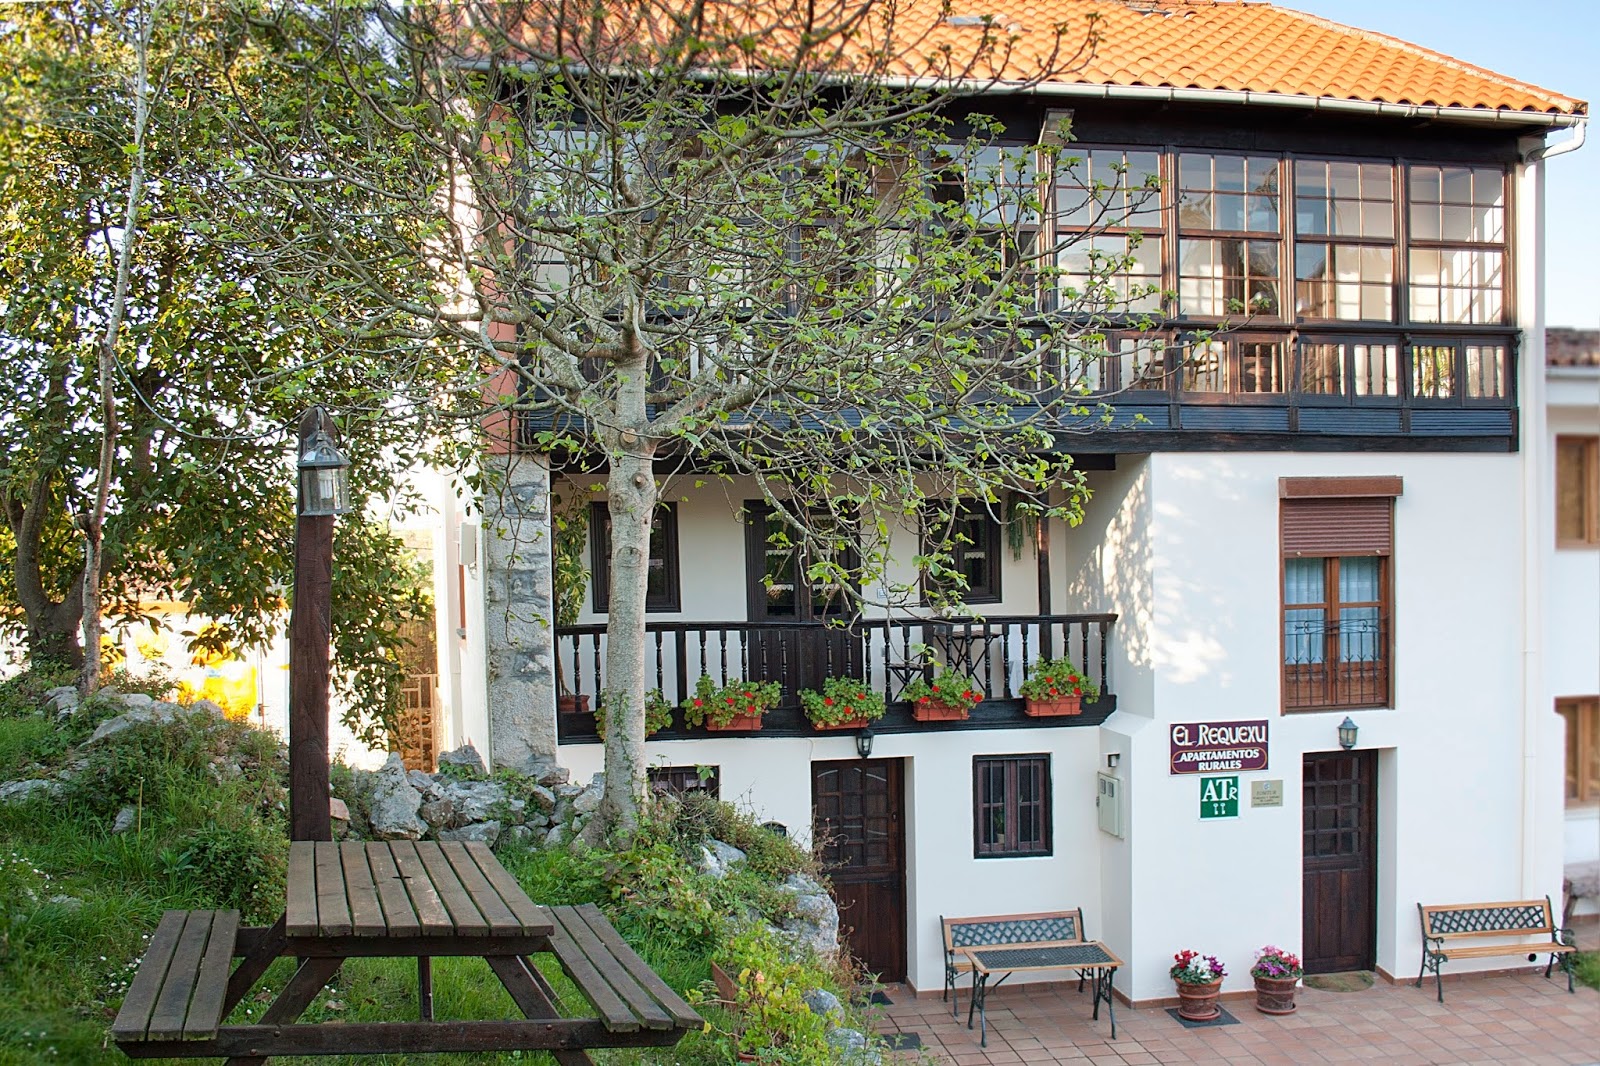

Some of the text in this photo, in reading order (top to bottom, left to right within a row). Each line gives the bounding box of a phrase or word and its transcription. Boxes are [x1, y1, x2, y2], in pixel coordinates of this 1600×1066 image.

[1172, 724, 1268, 748] EL REQUEXU
[1175, 749, 1260, 762] APARTAMENTOS
[1198, 760, 1242, 771] RURALES
